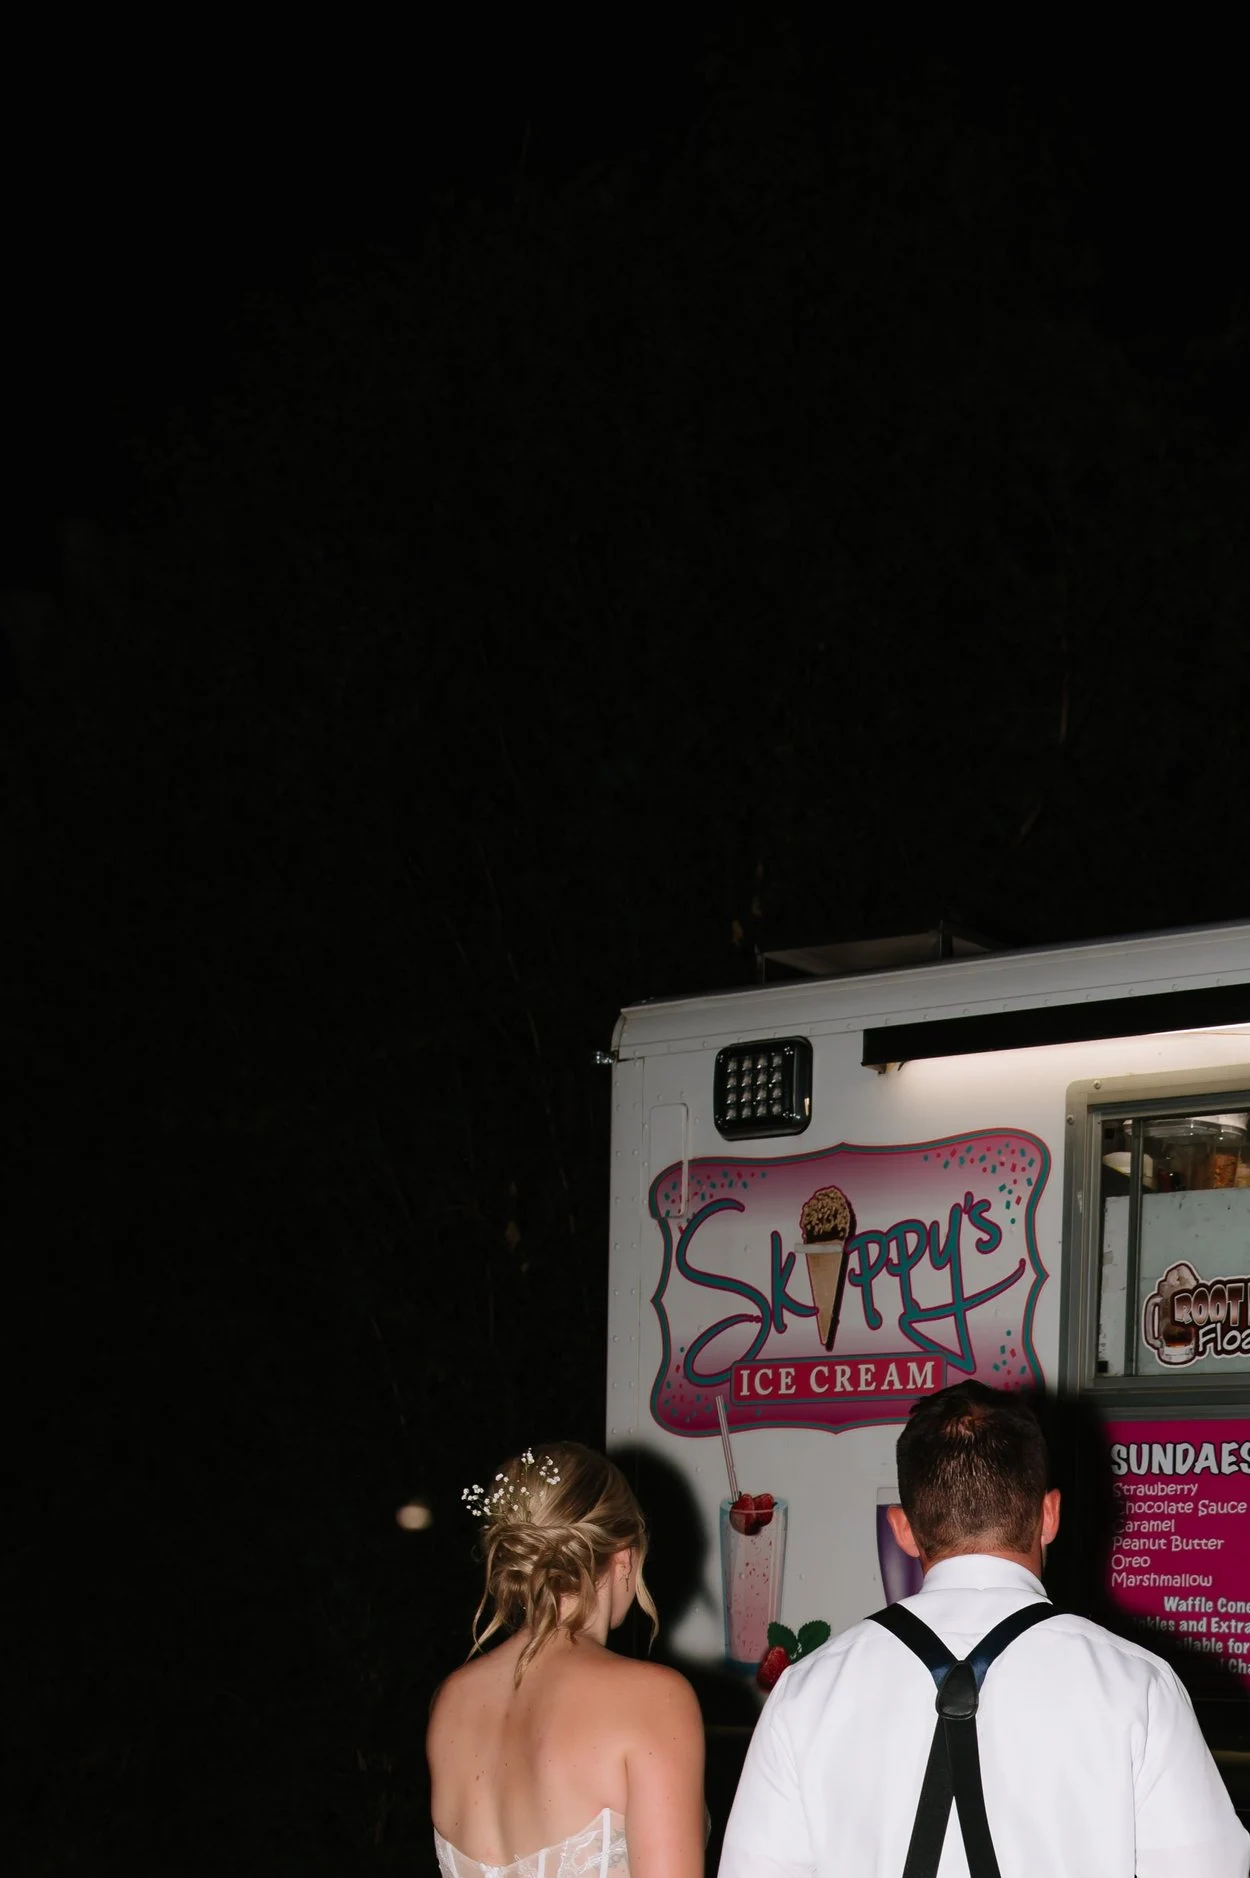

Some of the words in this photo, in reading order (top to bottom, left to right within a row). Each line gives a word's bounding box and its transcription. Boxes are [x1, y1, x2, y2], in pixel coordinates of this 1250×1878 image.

[1174, 1283, 1245, 1327] ROOT
[740, 1368, 796, 1396] ICE
[810, 1361, 935, 1393] CREAM
[1113, 1482, 1198, 1497] Strawberry
[1198, 1500, 1248, 1516] Sauce
[1112, 1537, 1167, 1552] Peanut
[1170, 1536, 1224, 1551] Butter
[1111, 1554, 1151, 1570] Oreo
[1111, 1572, 1213, 1588] Marshmallow
[1163, 1596, 1213, 1613] Waffle
[1179, 1617, 1207, 1632] and
[1227, 1638, 1250, 1655] for
